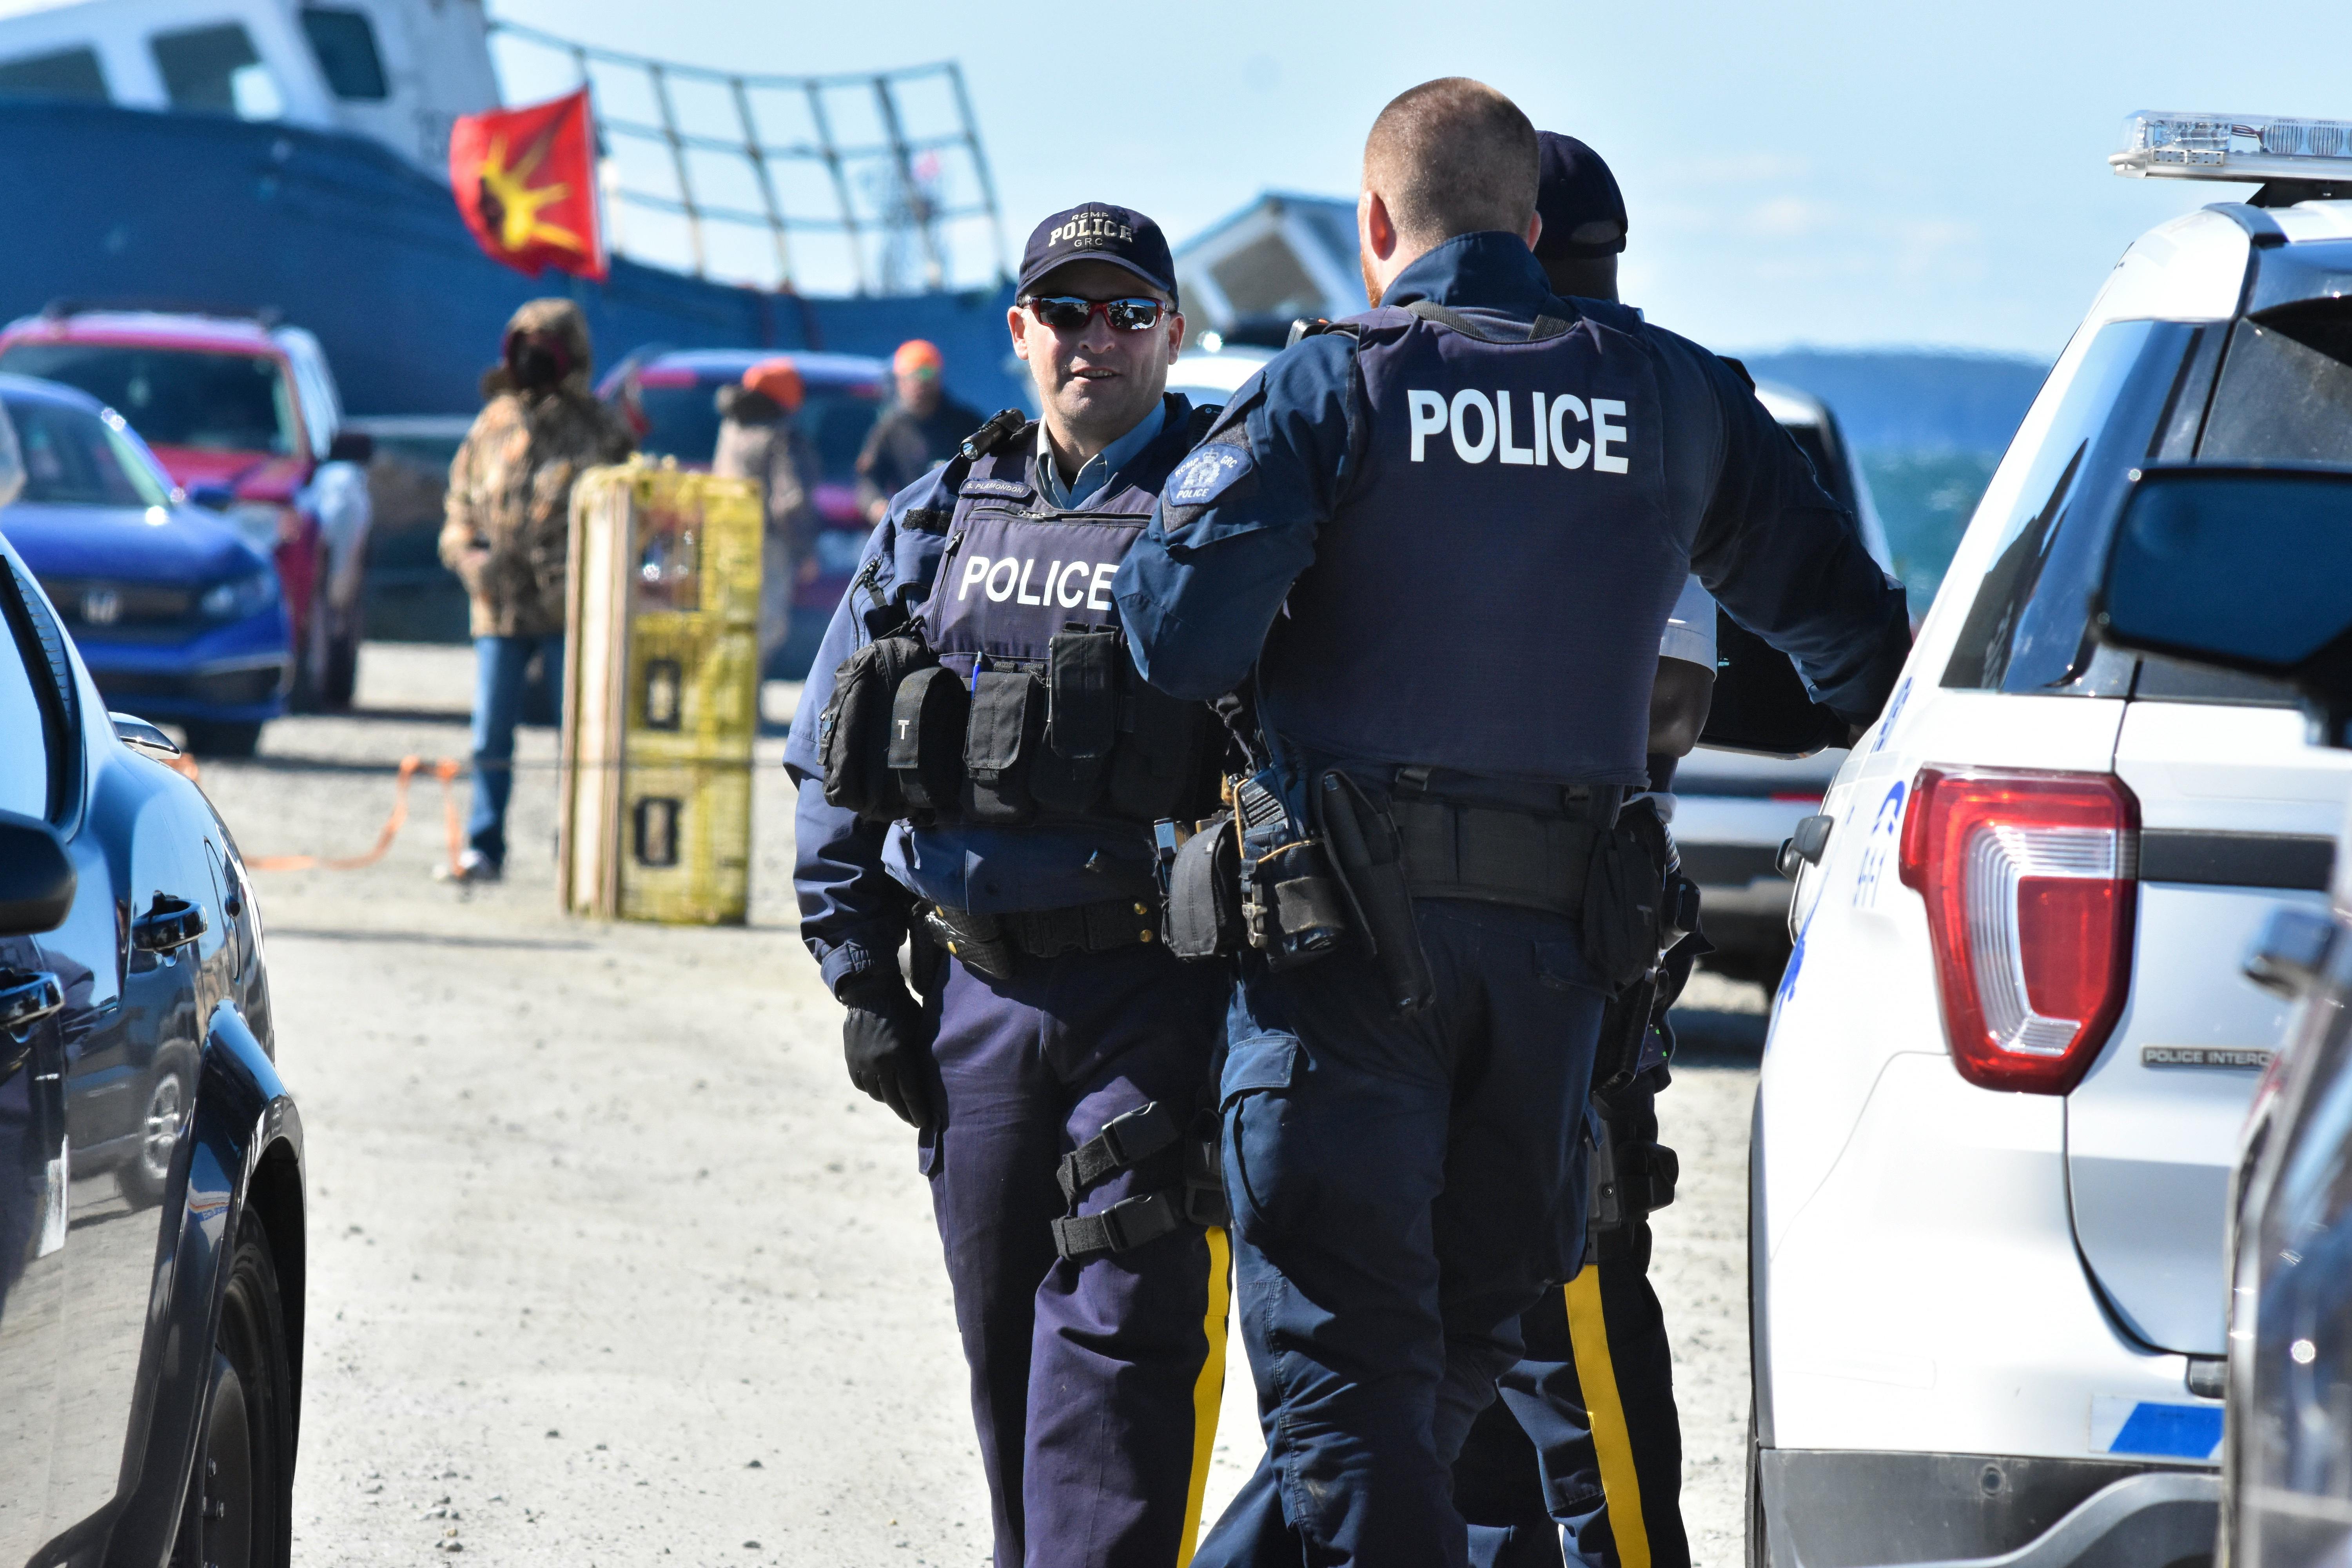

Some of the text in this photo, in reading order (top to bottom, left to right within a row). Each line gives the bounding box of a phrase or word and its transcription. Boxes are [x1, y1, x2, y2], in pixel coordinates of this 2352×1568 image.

[1072, 212, 1109, 220] RCMP
[1049, 219, 1132, 247] POLICE
[1074, 238, 1103, 247] GRC
[1408, 389, 1628, 474] POLICE
[1175, 455, 1237, 477] RCMP GRC
[975, 483, 1024, 493] PLAMONDON
[1176, 488, 1210, 499] POLICE
[958, 556, 1120, 611] POLICE
[898, 720, 909, 740] T
[2146, 1049, 2203, 1063] POLICE
